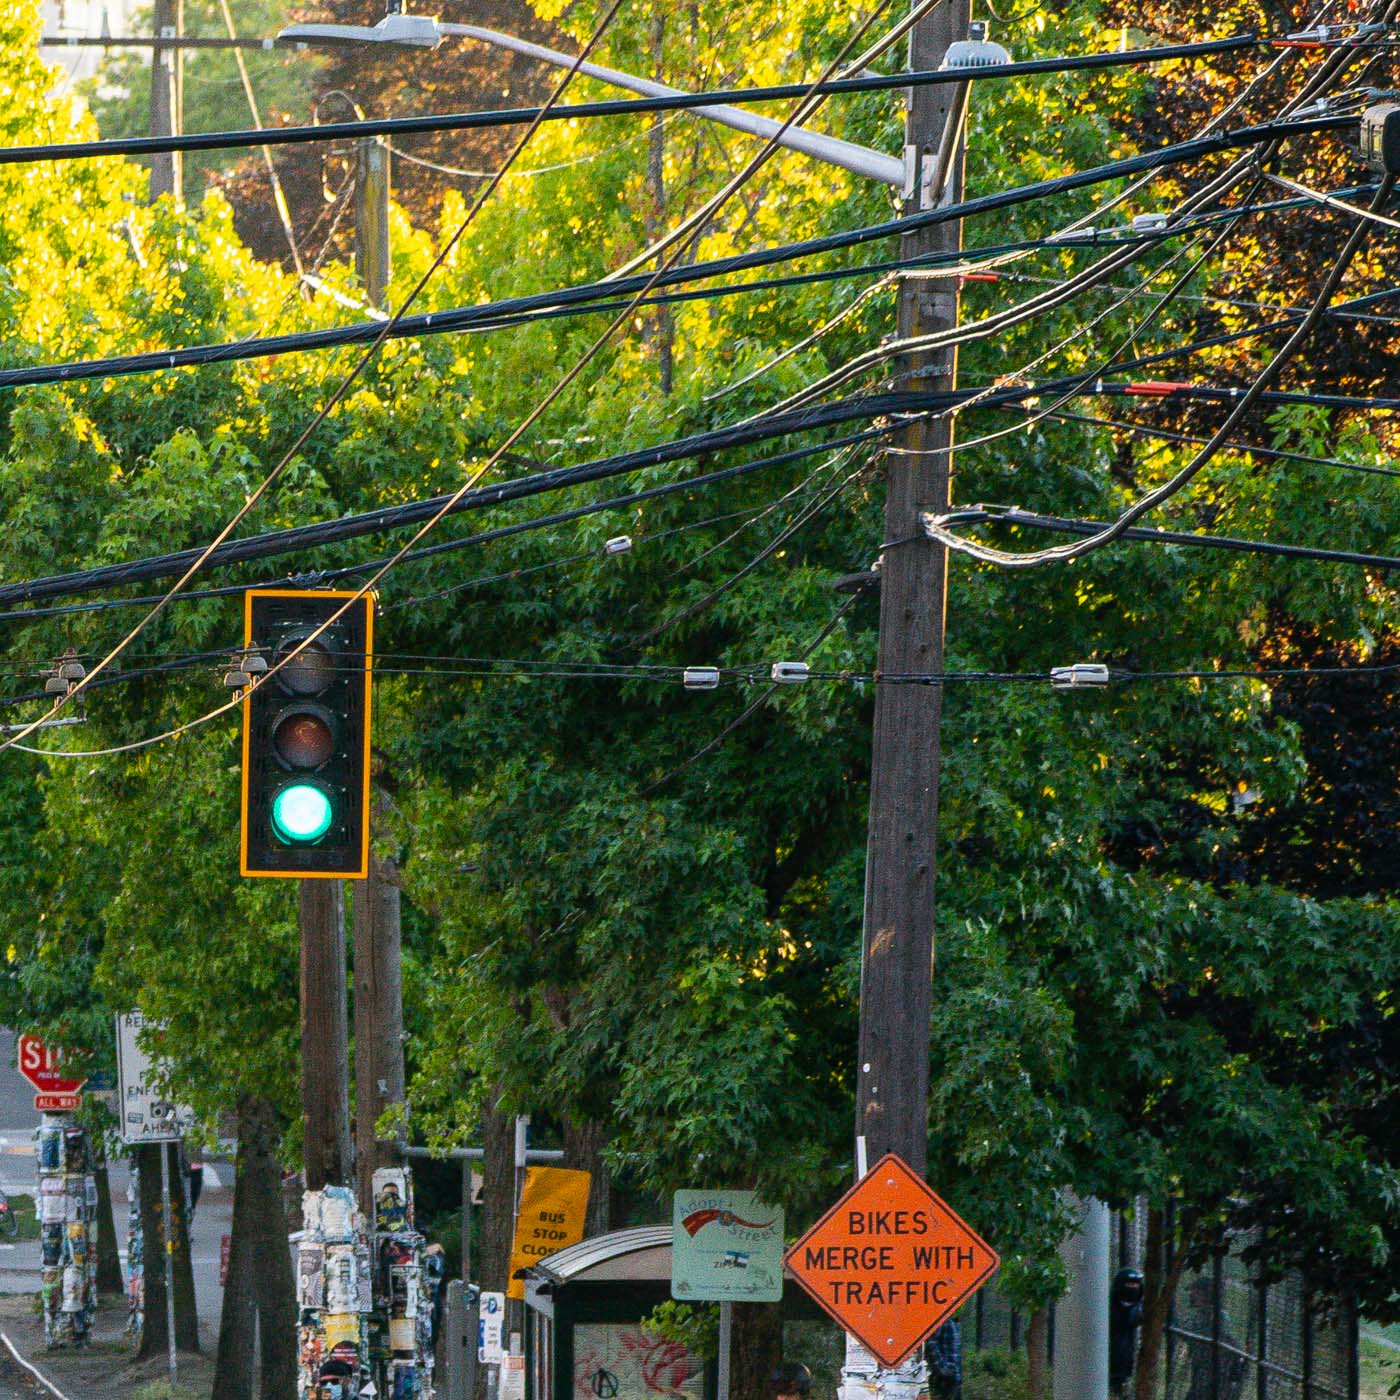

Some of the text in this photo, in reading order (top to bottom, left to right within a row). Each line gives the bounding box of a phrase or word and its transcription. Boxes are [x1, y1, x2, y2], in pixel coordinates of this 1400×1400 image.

[38, 1098, 54, 1107] ALL
[539, 1212, 566, 1224] BUS
[849, 1211, 928, 1235] BIKES
[533, 1228, 567, 1240] STOP
[805, 1247, 975, 1270] MERGE WITH
[829, 1281, 948, 1305] TRAFFIC
